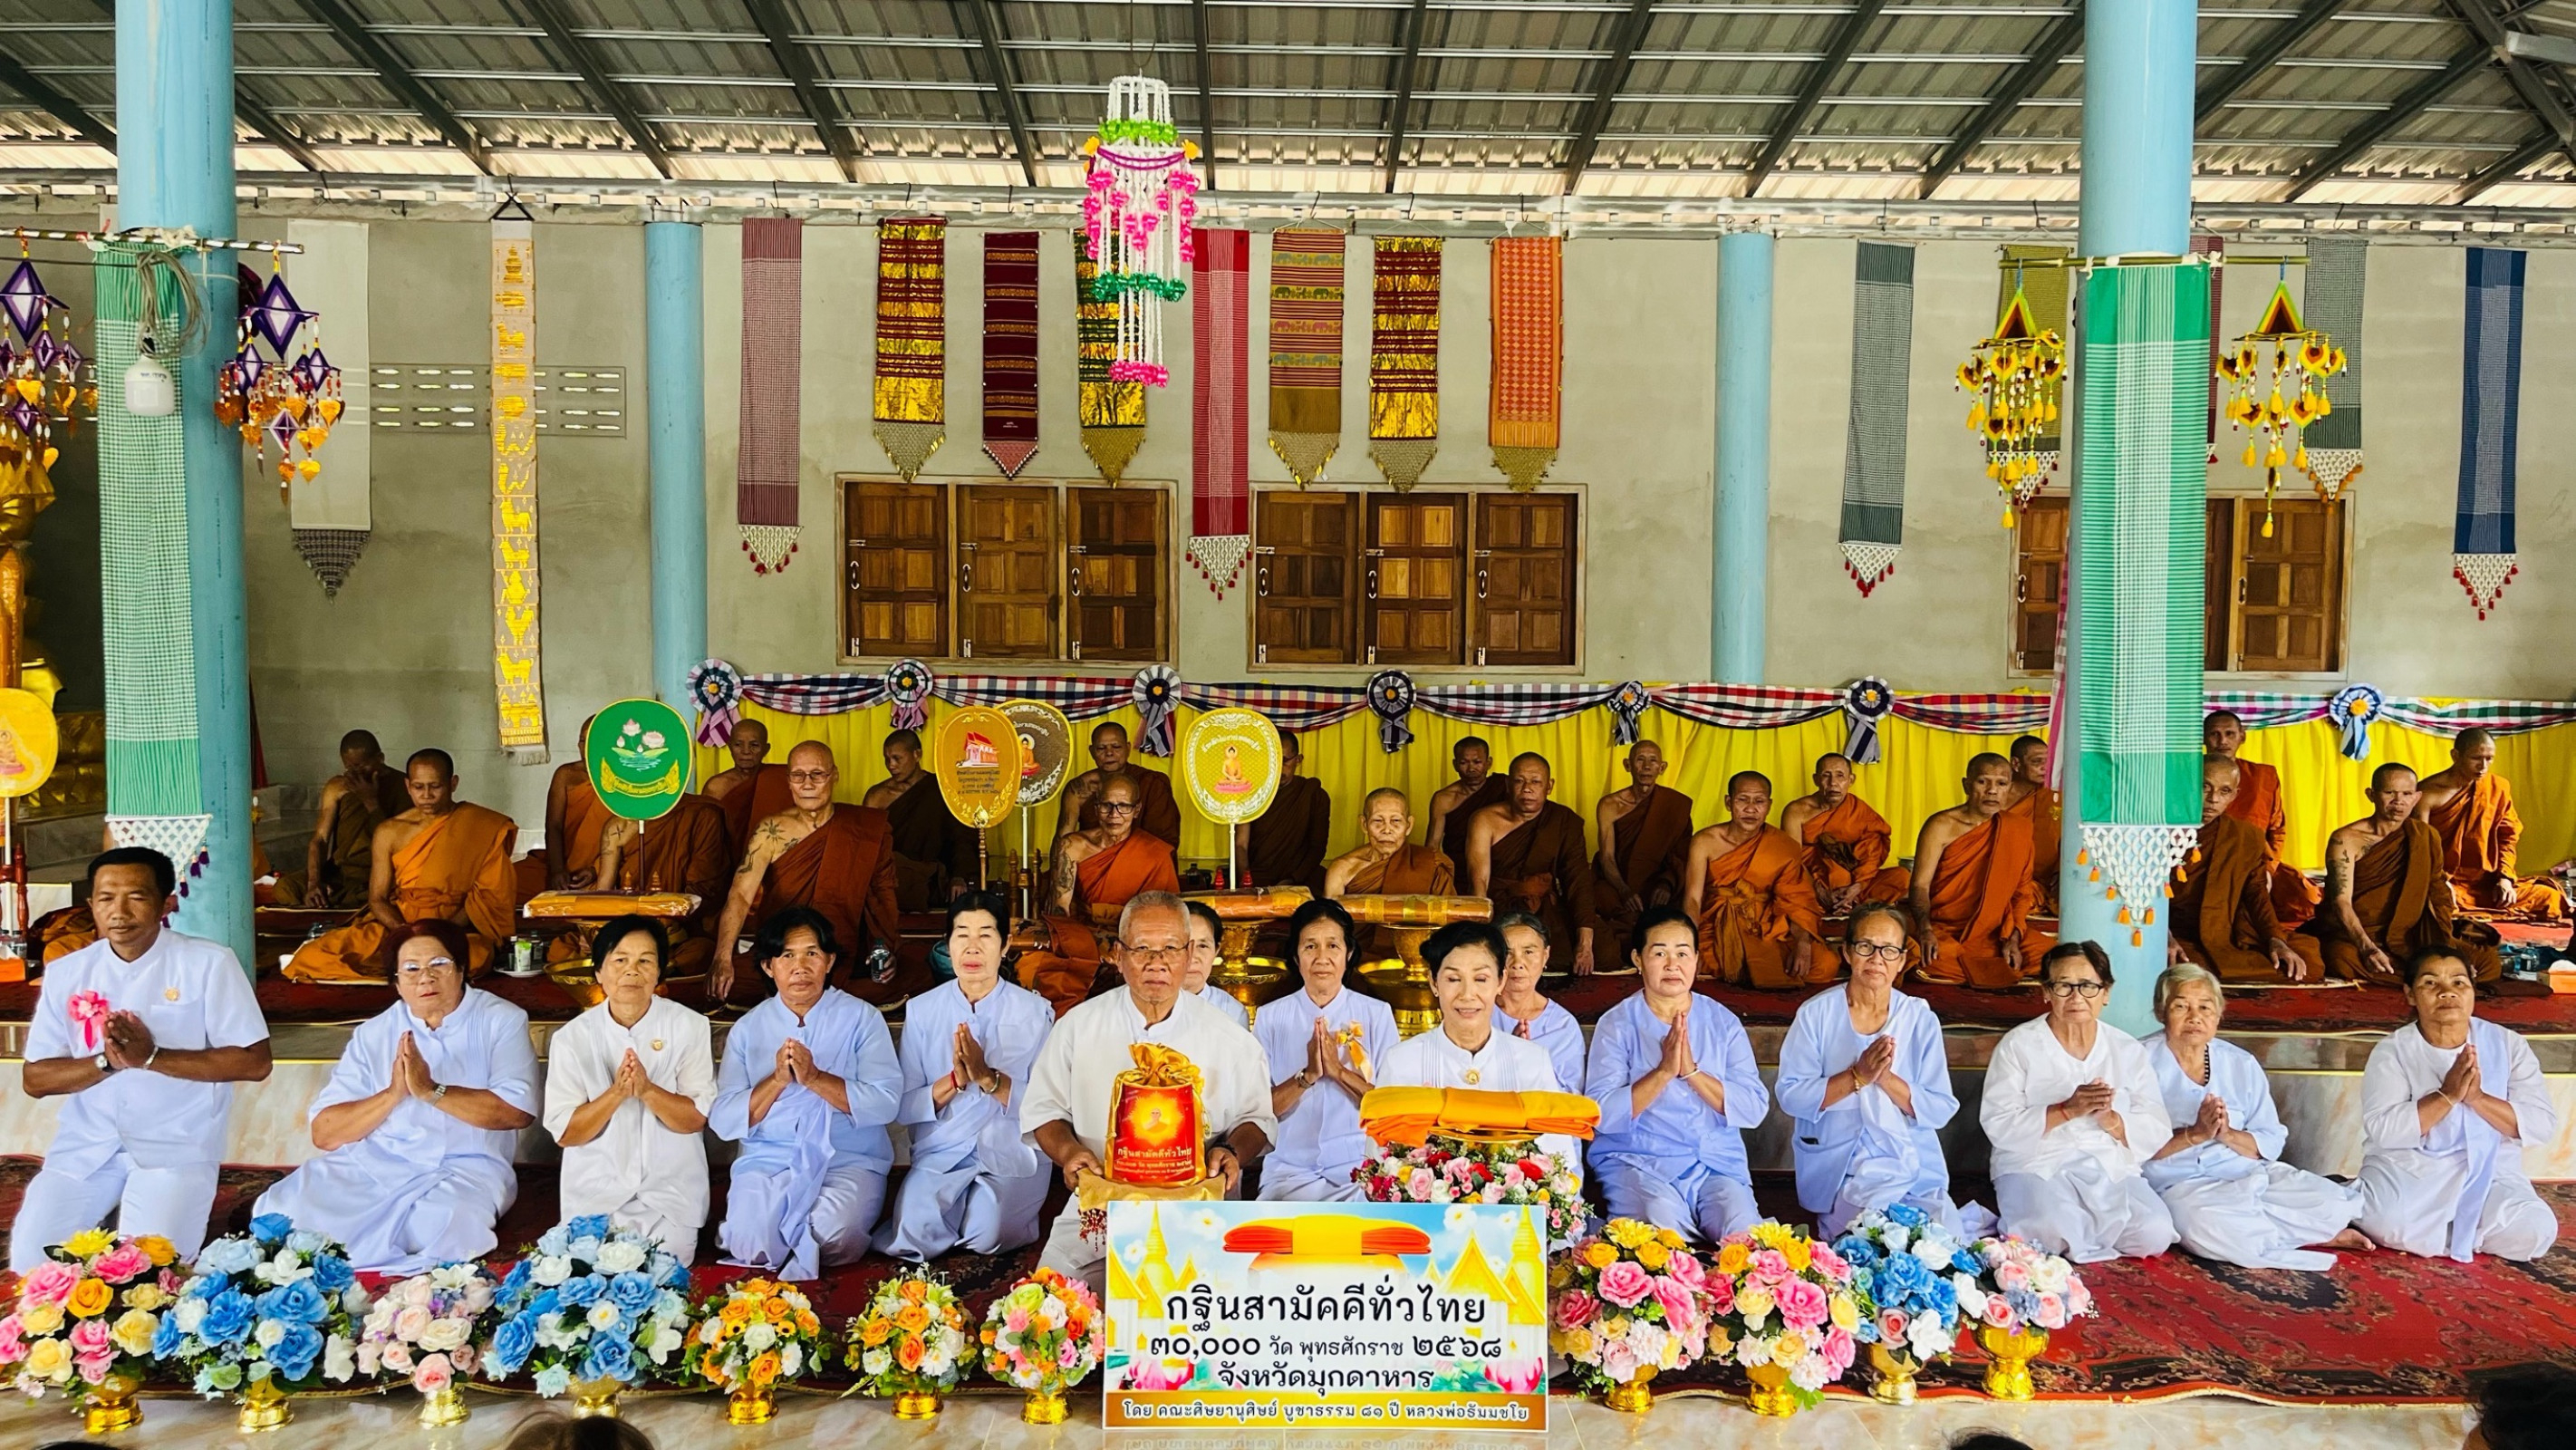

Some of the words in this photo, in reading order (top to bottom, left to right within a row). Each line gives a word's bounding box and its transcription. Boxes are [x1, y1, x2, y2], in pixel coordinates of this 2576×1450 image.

[1167, 1274, 1485, 1332] กฐินสามัคคีทั่วไทย
[1151, 1338, 1260, 1359] ๓๐,๐๐๐
[1269, 1335, 1293, 1356] วัด
[1299, 1335, 1404, 1363] พุทธศักราช
[1412, 1335, 1501, 1358] ๒๕๖๘
[1218, 1360, 1434, 1397] จังหวัดมุกดาหาร
[1124, 1401, 1152, 1416] โดย
[1159, 1400, 1277, 1422] คณะศิษยานุศิษย์
[1283, 1406, 1355, 1422] บูชาธรรม
[1361, 1406, 1383, 1417] ๘๑
[1389, 1402, 1400, 1417] ปี
[1405, 1403, 1529, 1420] หลวงพ่อธัมมชโย
